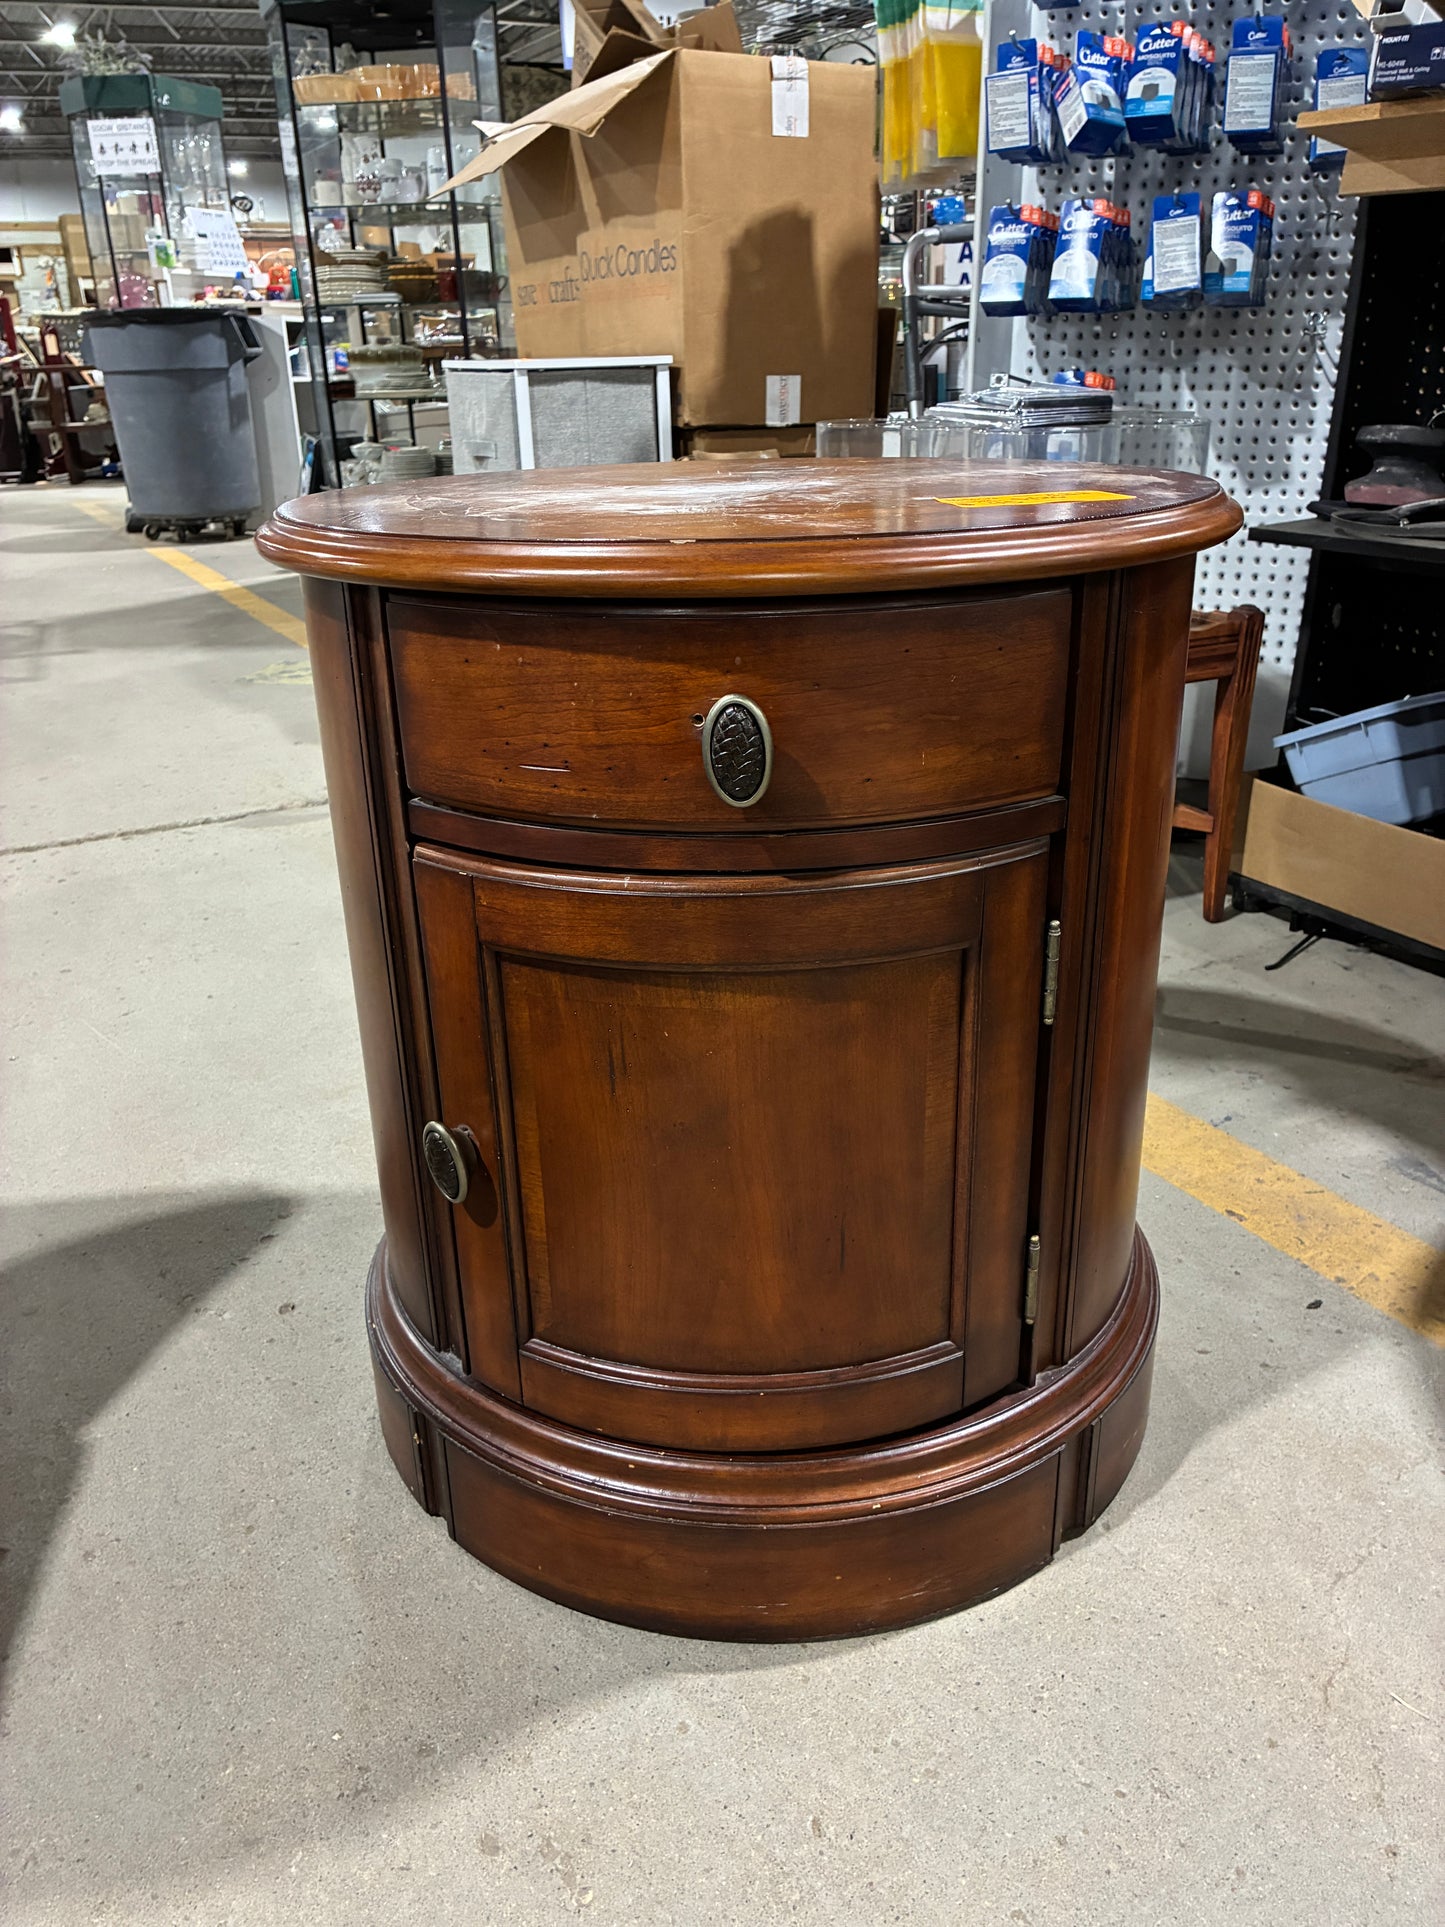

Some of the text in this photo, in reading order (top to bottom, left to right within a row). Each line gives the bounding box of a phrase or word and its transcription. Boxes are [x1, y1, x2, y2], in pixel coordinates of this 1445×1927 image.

[1139, 37, 1178, 53] Cutter
[1079, 46, 1110, 65] Cutter
[1137, 52, 1176, 61] MOSQUITO
[580, 238, 677, 283] Quick Candles
